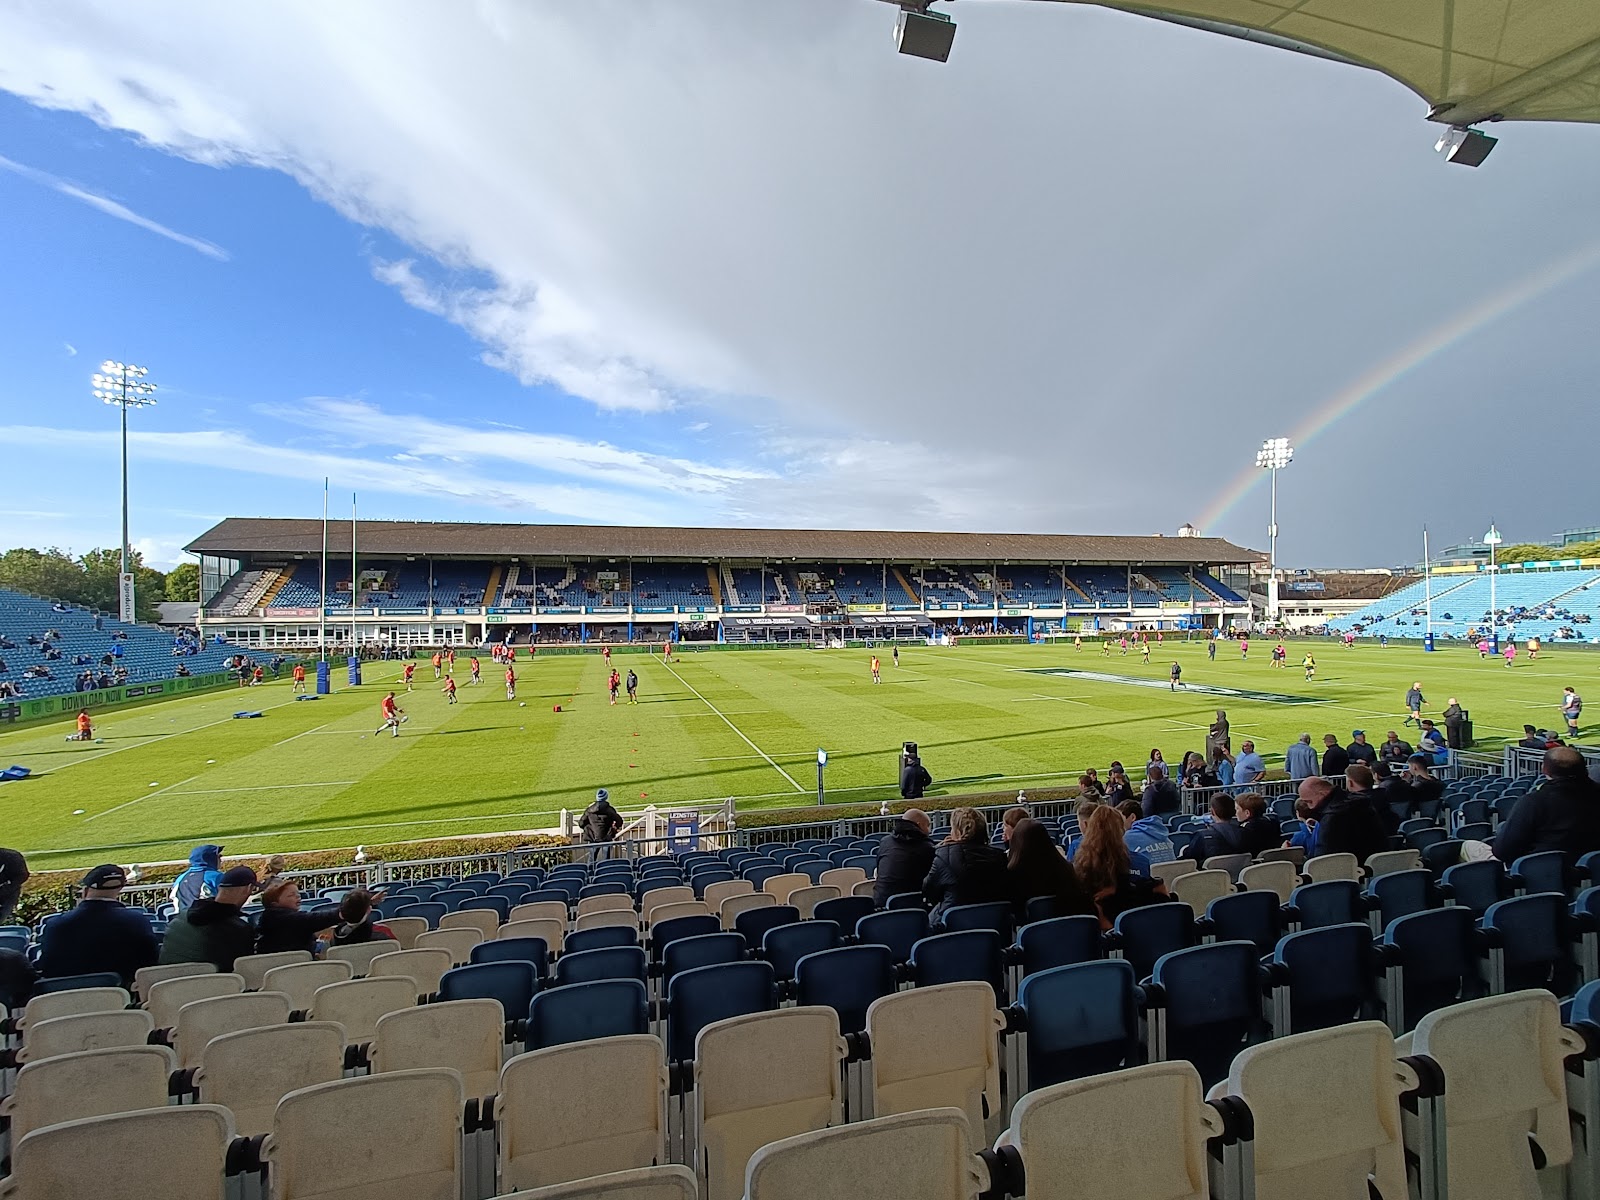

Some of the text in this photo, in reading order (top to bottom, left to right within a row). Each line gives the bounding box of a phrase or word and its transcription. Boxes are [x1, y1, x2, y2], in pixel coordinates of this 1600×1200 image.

[62, 692, 103, 711] DOWNLOAD
[105, 689, 122, 702] NOW
[1145, 842, 1168, 852] CLASS
